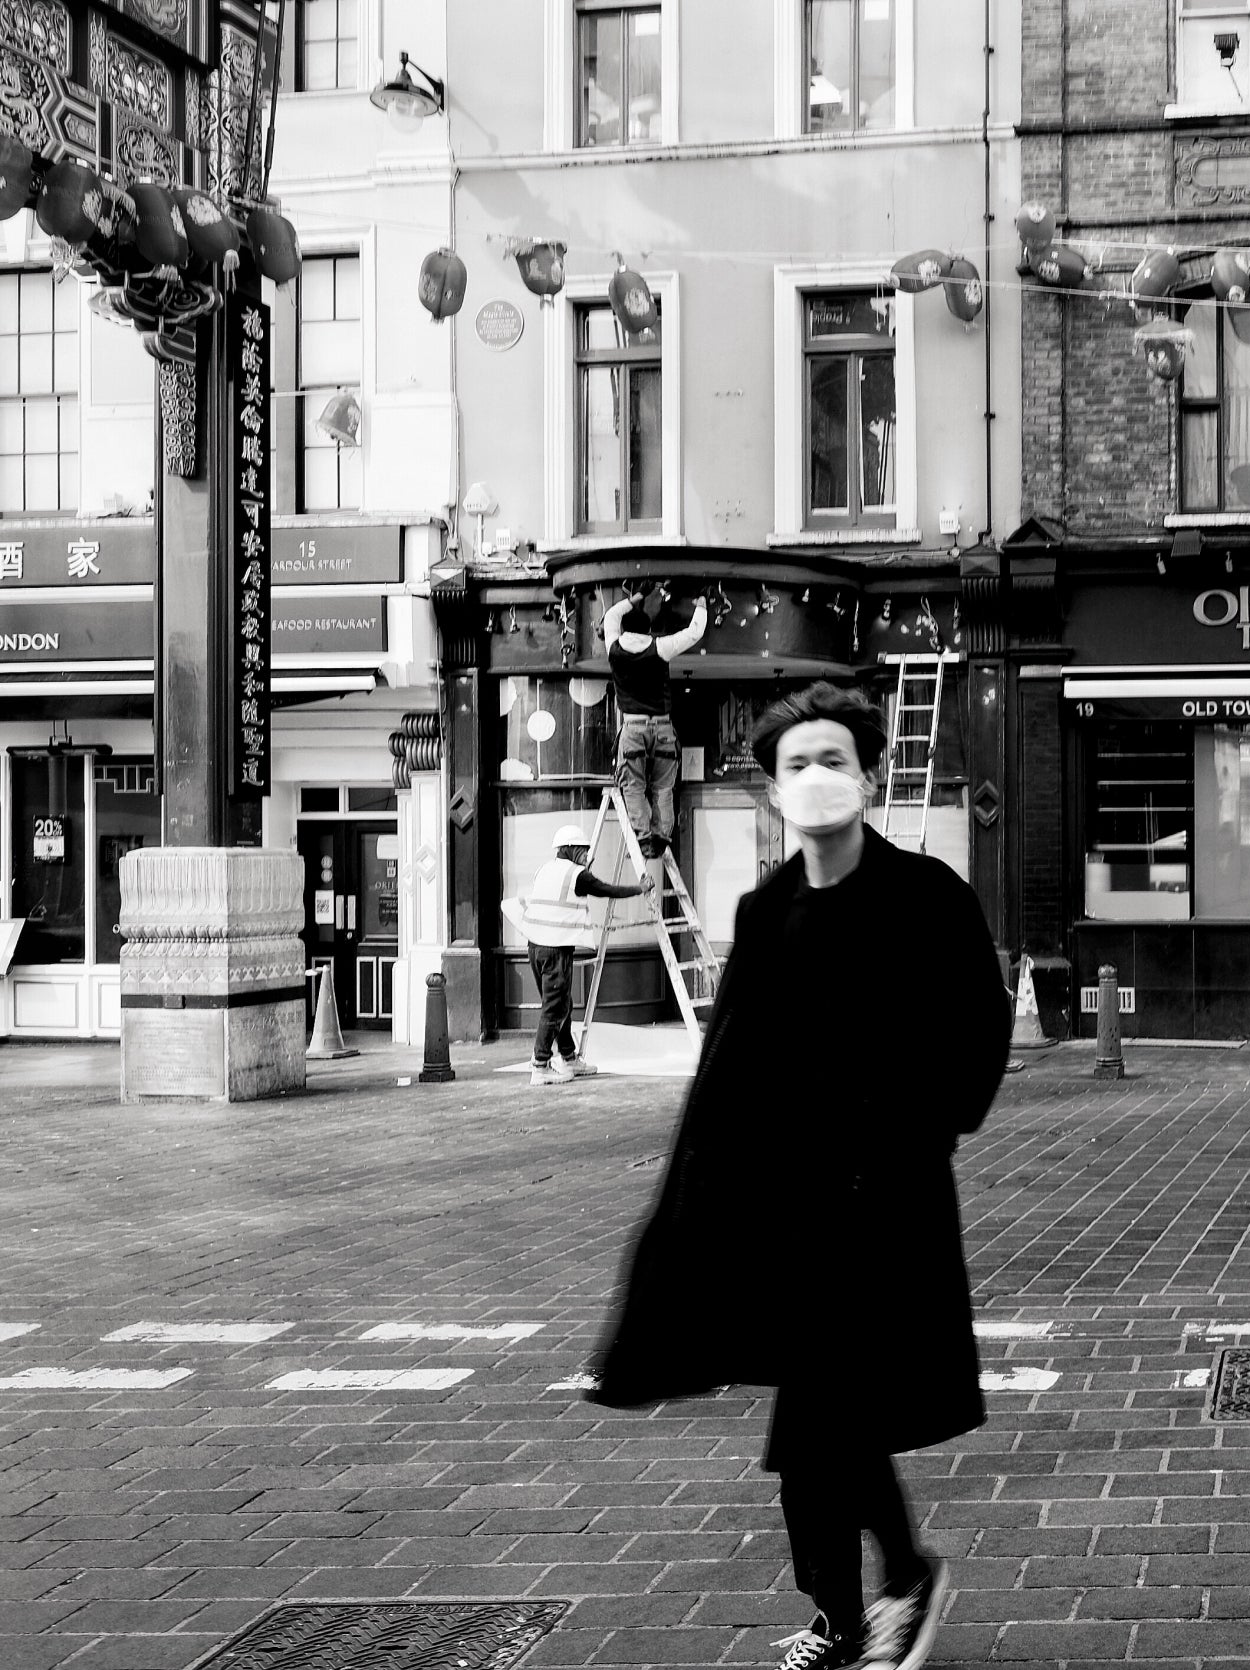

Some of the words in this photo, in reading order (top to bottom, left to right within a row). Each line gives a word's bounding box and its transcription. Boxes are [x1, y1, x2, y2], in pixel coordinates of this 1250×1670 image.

[299, 540, 317, 558] 15
[271, 560, 315, 572] ARDOUR
[317, 559, 353, 571] STREET
[271, 619, 312, 632] EAFOOD
[315, 617, 378, 630] RESTAURANT
[0, 632, 60, 651] NDON
[1075, 702, 1095, 718] 19
[1182, 701, 1219, 717] OLD
